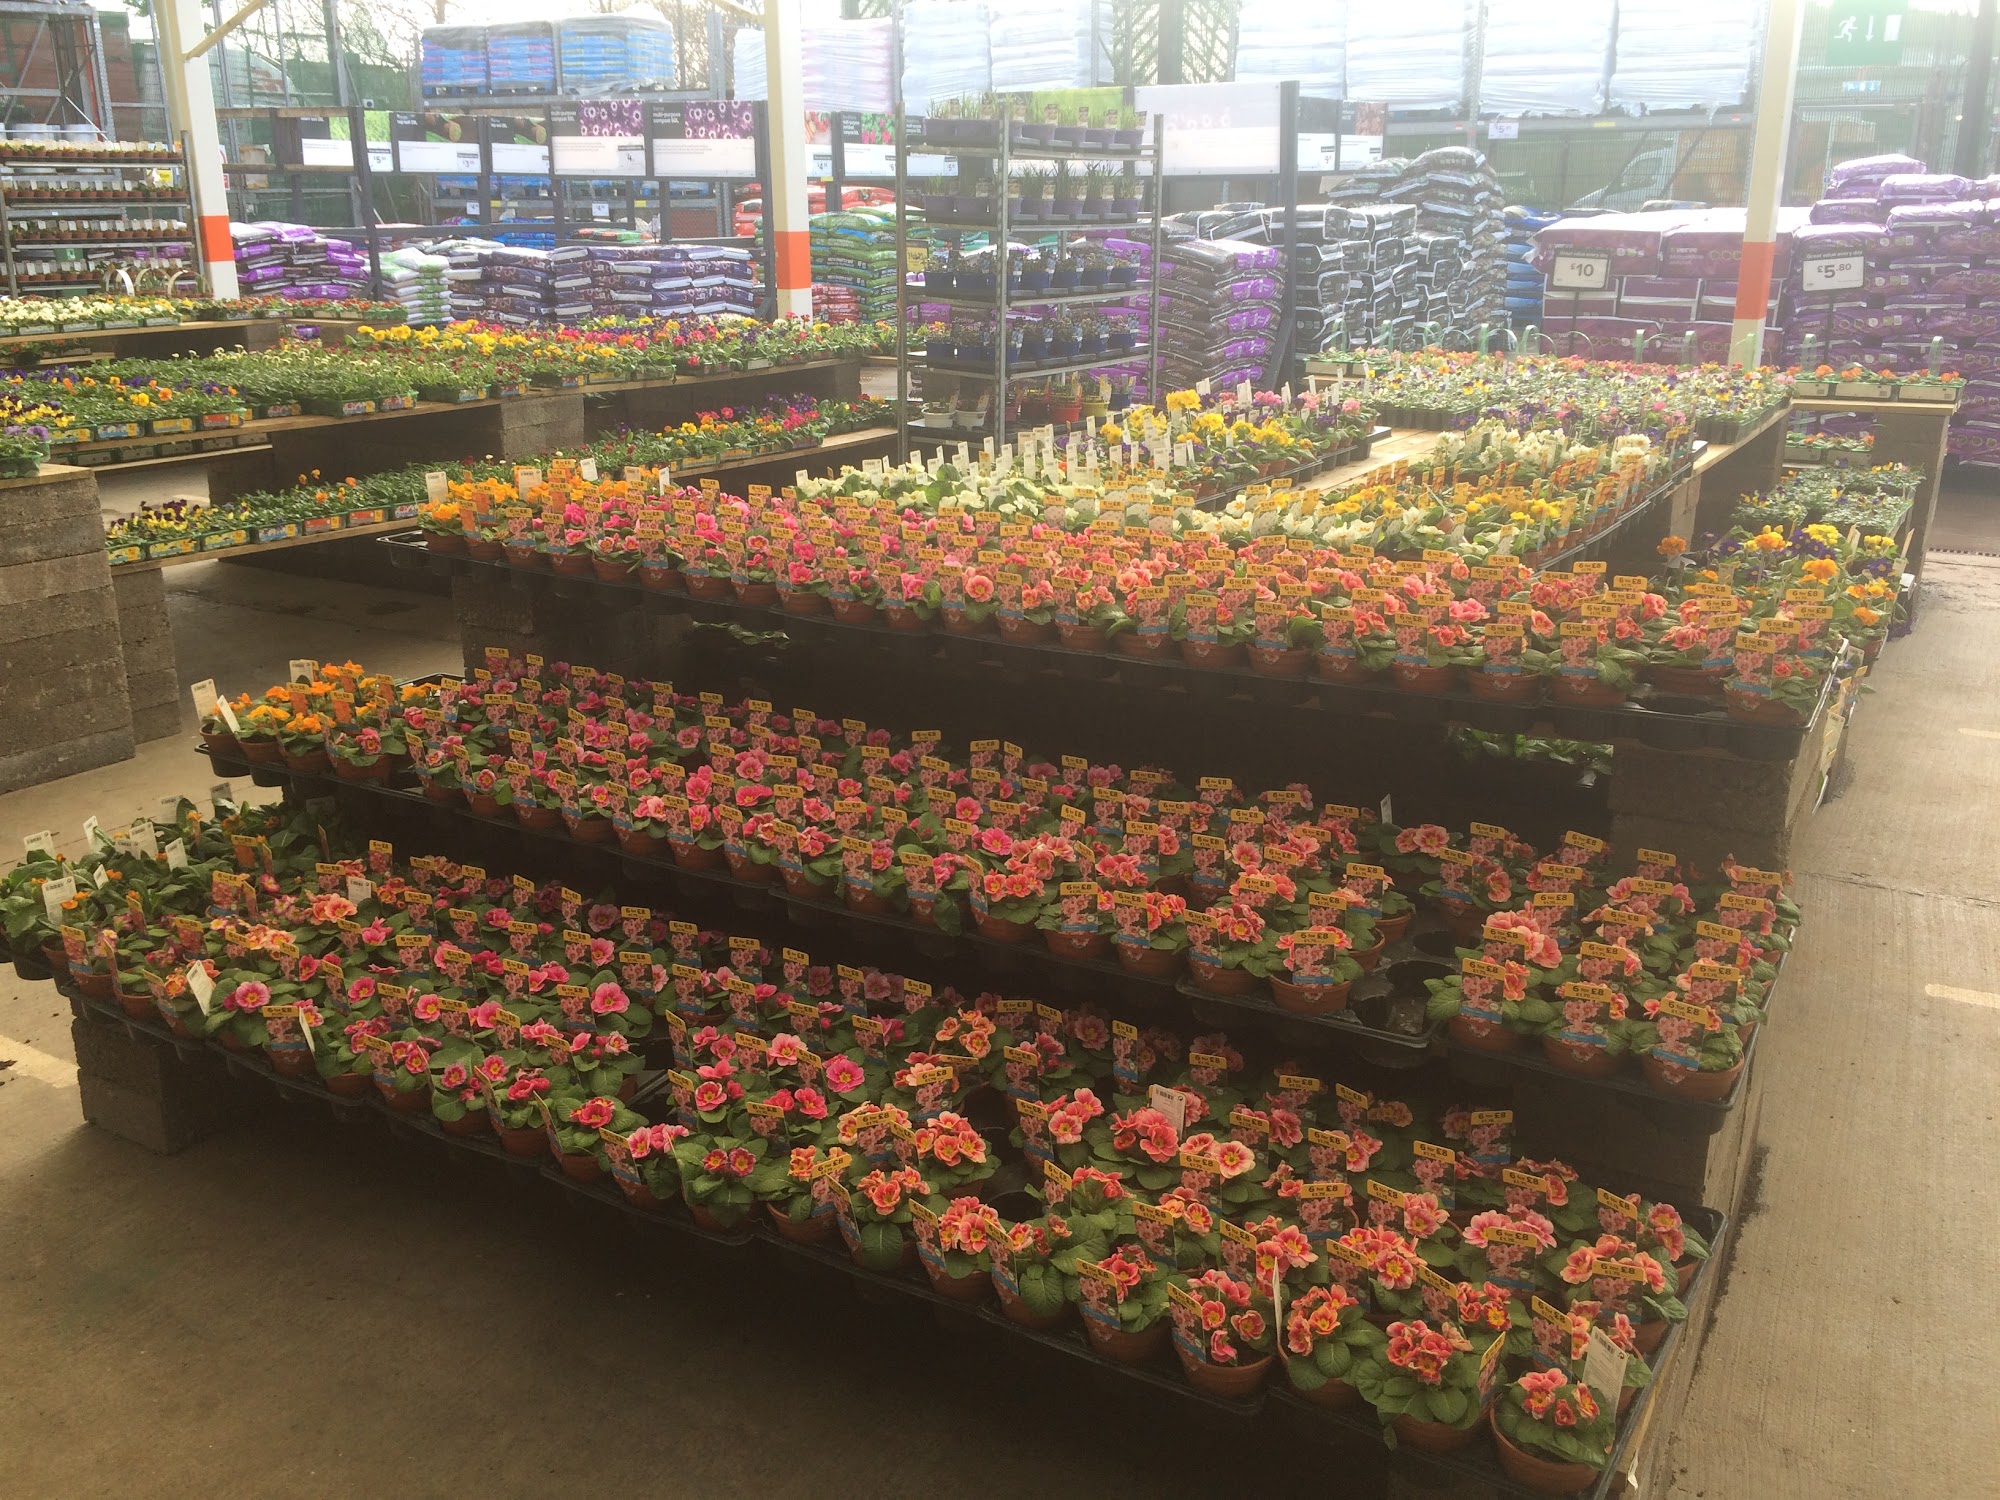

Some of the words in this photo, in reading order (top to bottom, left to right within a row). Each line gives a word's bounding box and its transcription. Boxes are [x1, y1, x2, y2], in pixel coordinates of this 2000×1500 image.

[1571, 263, 1594, 277] £10
[1817, 263, 1852, 278] £5.80
[1487, 965, 1498, 973] £8
[1687, 1007, 1699, 1016] £8
[1436, 1148, 1447, 1156] £8
[1527, 1176, 1539, 1185] £8
